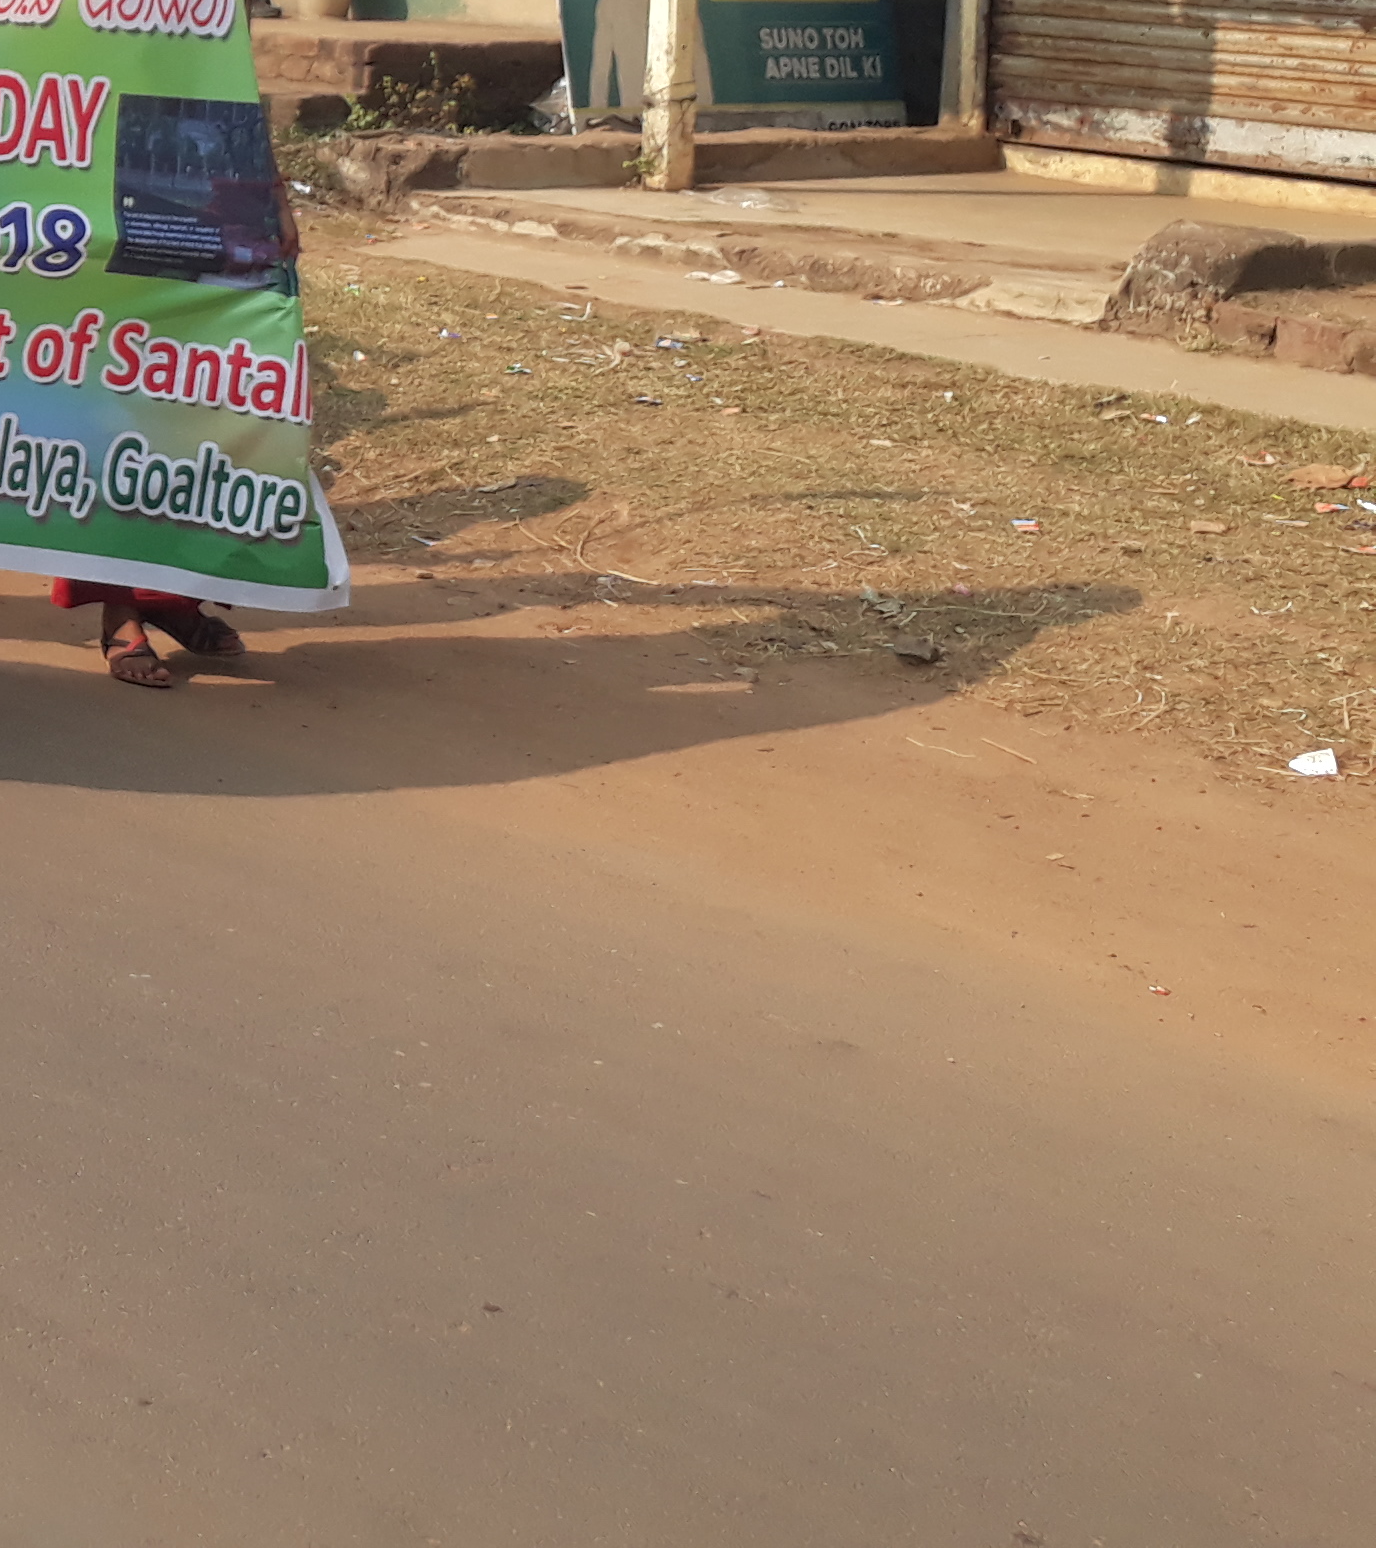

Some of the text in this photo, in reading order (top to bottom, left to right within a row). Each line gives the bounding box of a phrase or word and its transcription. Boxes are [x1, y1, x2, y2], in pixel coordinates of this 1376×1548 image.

[759, 27, 865, 50] SUNO TOH
[765, 57, 821, 80] APNE
[825, 57, 859, 80] DIL
[22, 307, 104, 384] of
[103, 431, 307, 539] Goaltore
